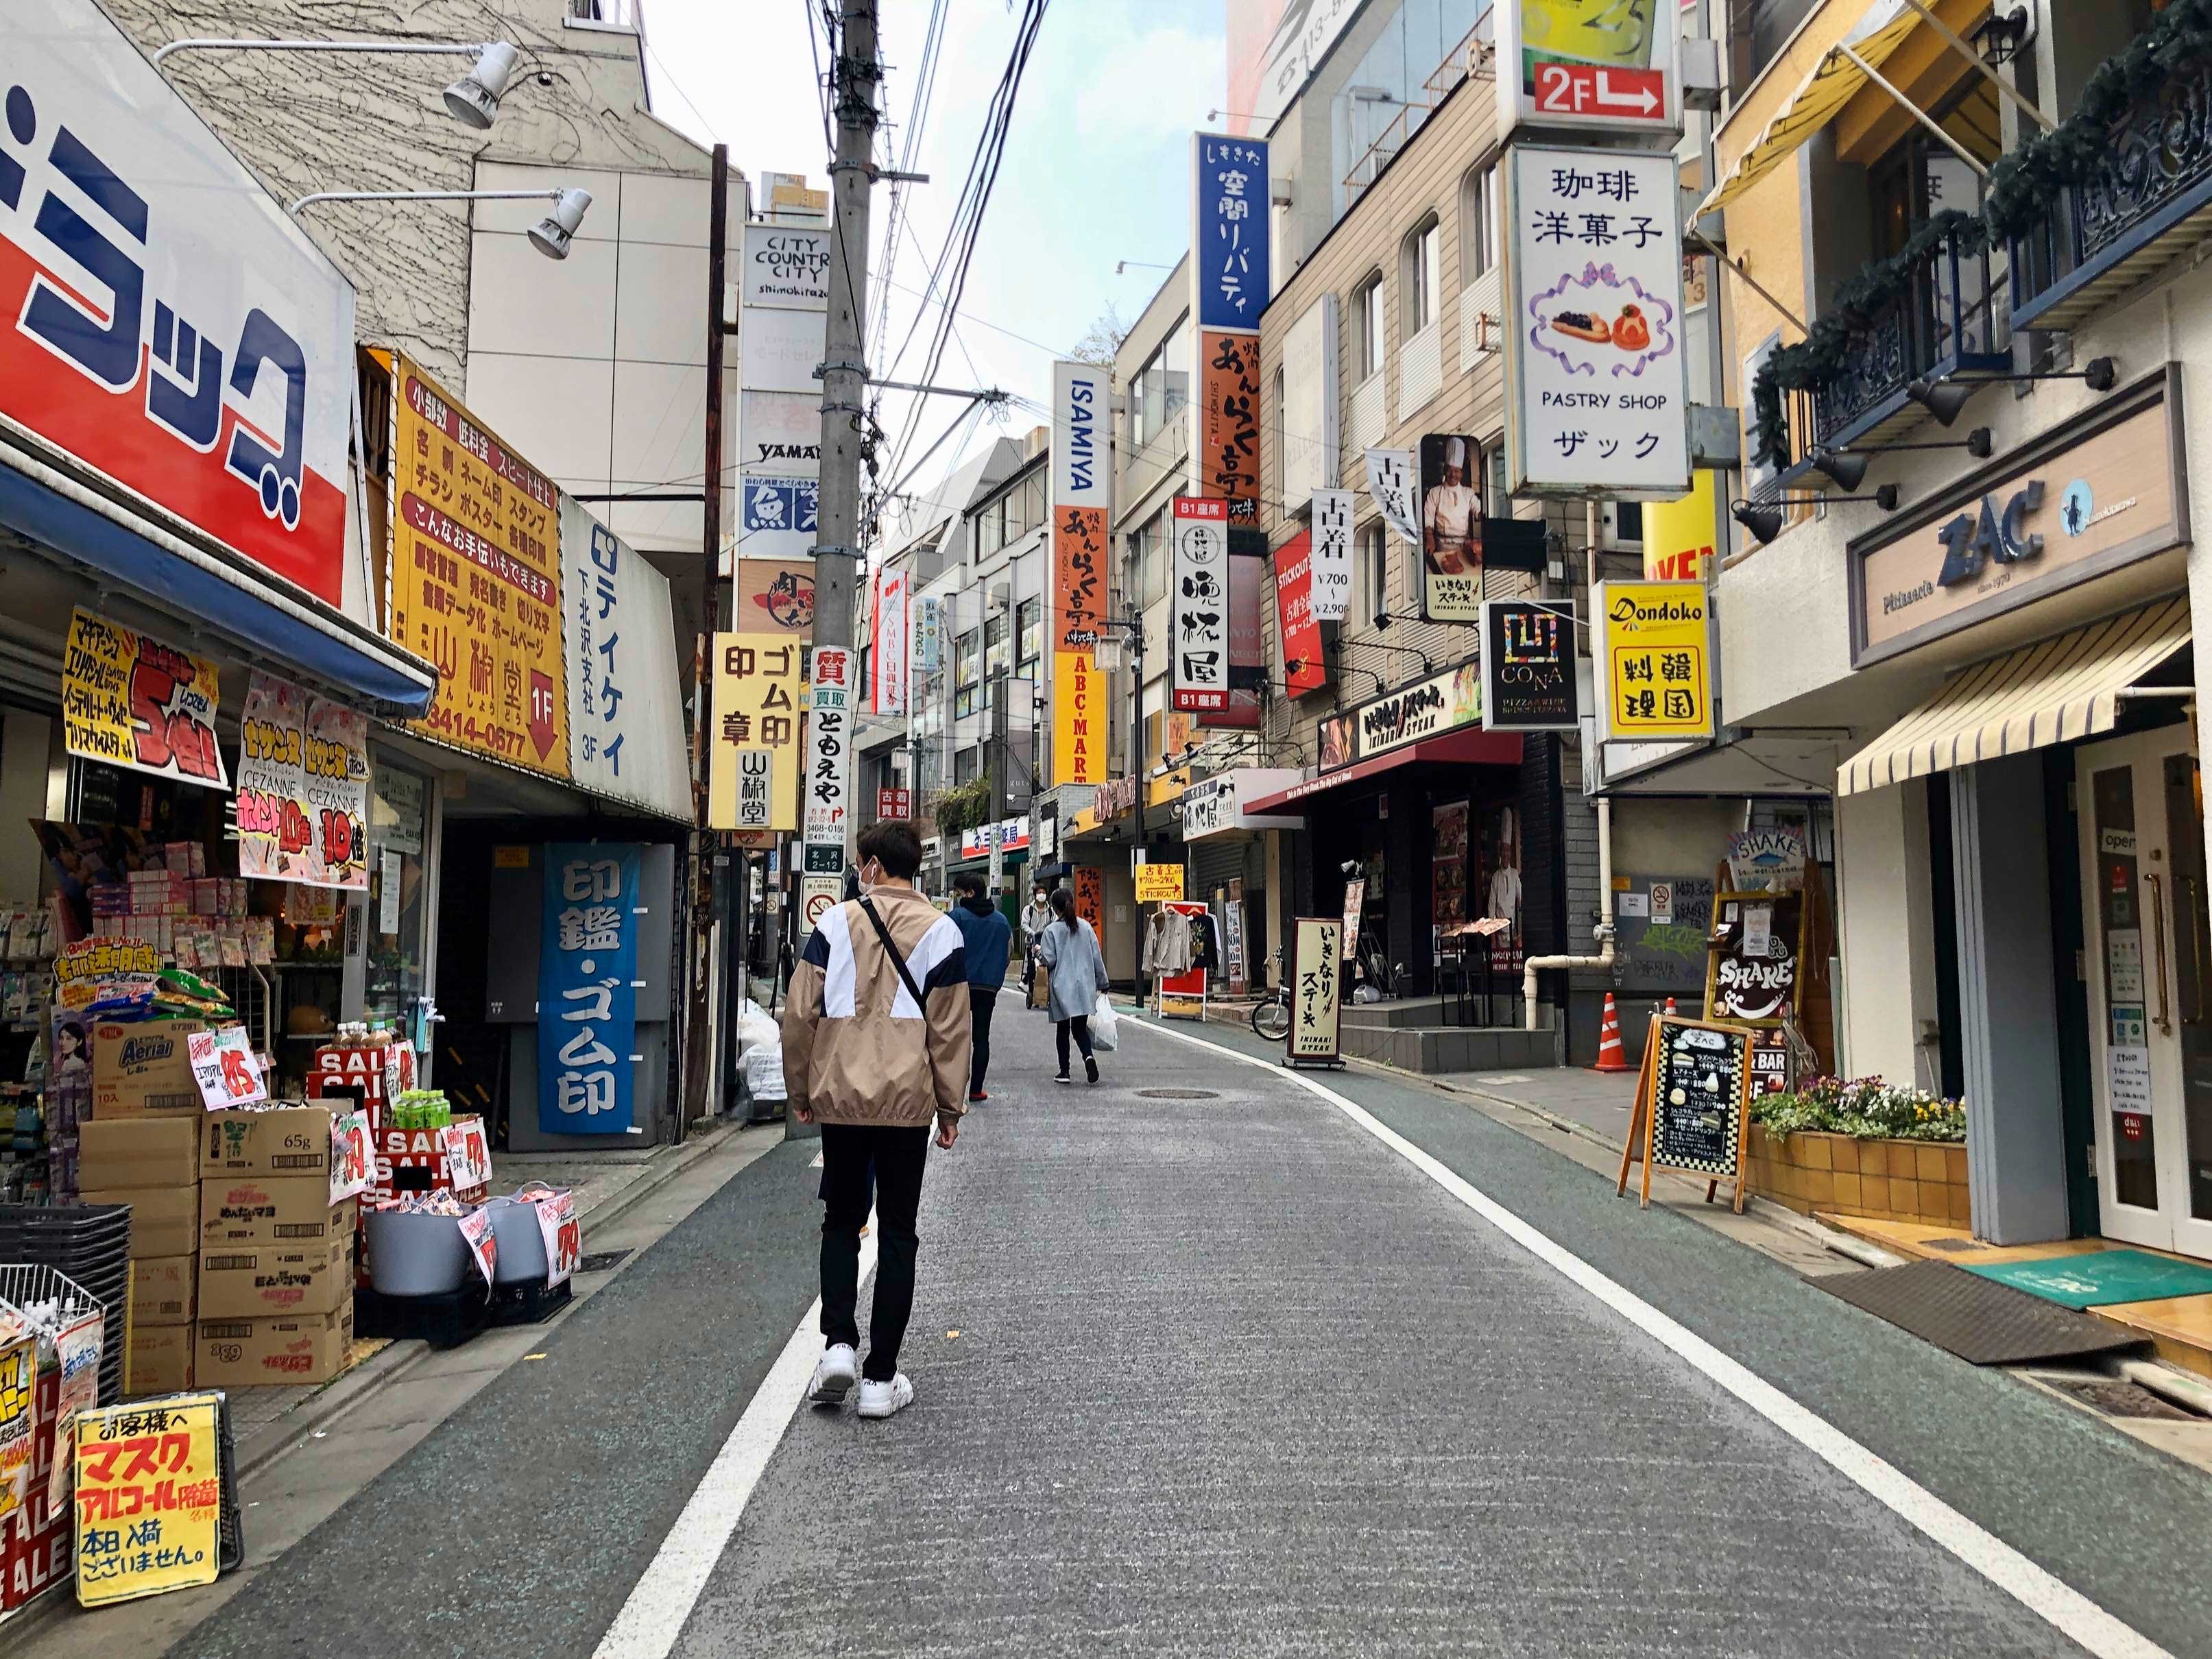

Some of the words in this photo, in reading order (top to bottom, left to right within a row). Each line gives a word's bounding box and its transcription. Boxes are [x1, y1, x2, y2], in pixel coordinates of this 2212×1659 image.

[1543, 66, 1590, 111] 2F
[1207, 143, 1260, 167] しもきた
[1552, 169, 1639, 202] 珈琲
[767, 237, 819, 252] CITY
[1218, 170, 1250, 317] 空間リバティ
[1532, 210, 1663, 248] 洋菓子
[756, 252, 830, 267] COUNTR
[773, 265, 823, 284] CITY
[1541, 392, 1610, 409] PASTRY
[1619, 394, 1667, 411] SHOP
[413, 383, 447, 431] 小部数
[458, 417, 489, 463] 低料金
[1071, 379, 1094, 492] ISAMIYA
[1554, 431, 1660, 460] ザック
[416, 463, 453, 502] チラシ
[509, 495, 546, 535] スタンプ
[1181, 501, 1220, 516] B1座席
[1318, 497, 1347, 559] 古着
[1937, 480, 2045, 588] ZAC
[415, 501, 549, 599] こんなお手伝いもできます
[1435, 579, 1471, 592] いきなり
[1439, 593, 1471, 603] ステーキ
[1609, 597, 1702, 622] Dondoko
[492, 616, 544, 659] ホームページ
[578, 567, 595, 716] 下北沢支社
[1181, 571, 1221, 684] 晩杯屋
[809, 651, 847, 685] 質
[1501, 666, 1563, 691] CONA
[721, 646, 756, 746] 印章
[760, 644, 795, 749] ゴム印
[816, 692, 845, 707] 買取
[1181, 693, 1222, 707] B1座席
[1624, 654, 1657, 719] 料理
[1661, 653, 1695, 719] 韓国
[531, 686, 553, 725] 1F
[243, 716, 302, 768] セザンヌ
[1406, 714, 1436, 736] STEAK
[304, 734, 348, 782] セザンヌ
[581, 733, 598, 764] 3F
[814, 711, 841, 804] ともえや
[243, 770, 296, 797] CEZANNE
[741, 751, 767, 825] 山椒堂
[882, 791, 907, 803] 古着
[307, 788, 359, 814] CEZANNE
[882, 804, 907, 817] 買取
[811, 850, 838, 860] 北沢
[1738, 833, 1799, 860] SHAKE
[812, 860, 838, 870] 2-12
[1319, 925, 1336, 998] いきなり
[1716, 957, 1798, 990] SHAKE
[557, 859, 622, 1115] 印鑑・ゴム印
[1301, 971, 1317, 1028] ステーキ
[119, 1037, 173, 1067] Aerial
[1757, 1052, 1785, 1069] BAR
[284, 1134, 311, 1150] 65g
[99, 1409, 188, 1440] お客様へ
[76, 1479, 219, 1525] アルコール除菌
[82, 1528, 119, 1557] 本日
[125, 1517, 162, 1550] 入荷
[83, 1545, 204, 1582] ございません。
